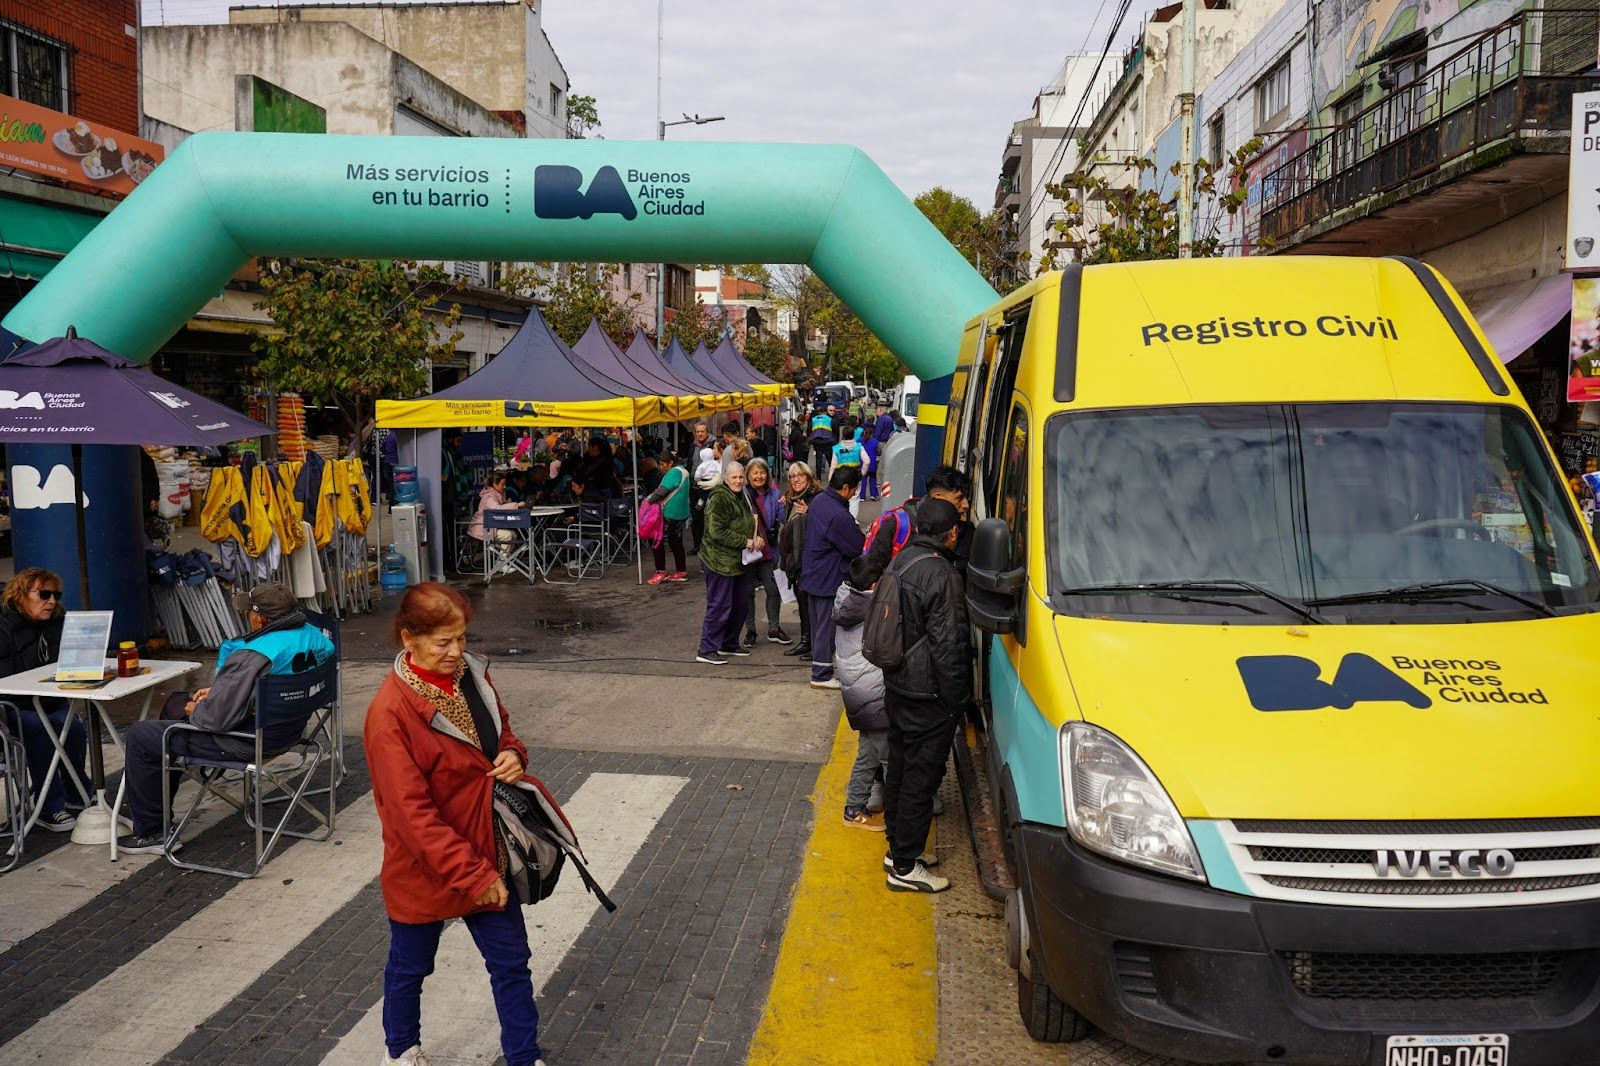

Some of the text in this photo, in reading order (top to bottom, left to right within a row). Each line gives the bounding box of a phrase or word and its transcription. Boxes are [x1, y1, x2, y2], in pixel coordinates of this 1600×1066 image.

[346, 164, 490, 183] Más servicios
[627, 169, 691, 183] Buenos
[372, 189, 489, 208] en tu barrio
[534, 165, 638, 221] BA
[638, 184, 685, 199] Aires
[643, 201, 705, 216] Ciudad
[1141, 315, 1399, 347] Registro Civil
[1391, 655, 1501, 671] Buenos
[1235, 652, 1433, 712] BA
[1423, 671, 1502, 686] Aires
[1439, 687, 1550, 705] Ciudad
[1375, 849, 1516, 878] IVECO
